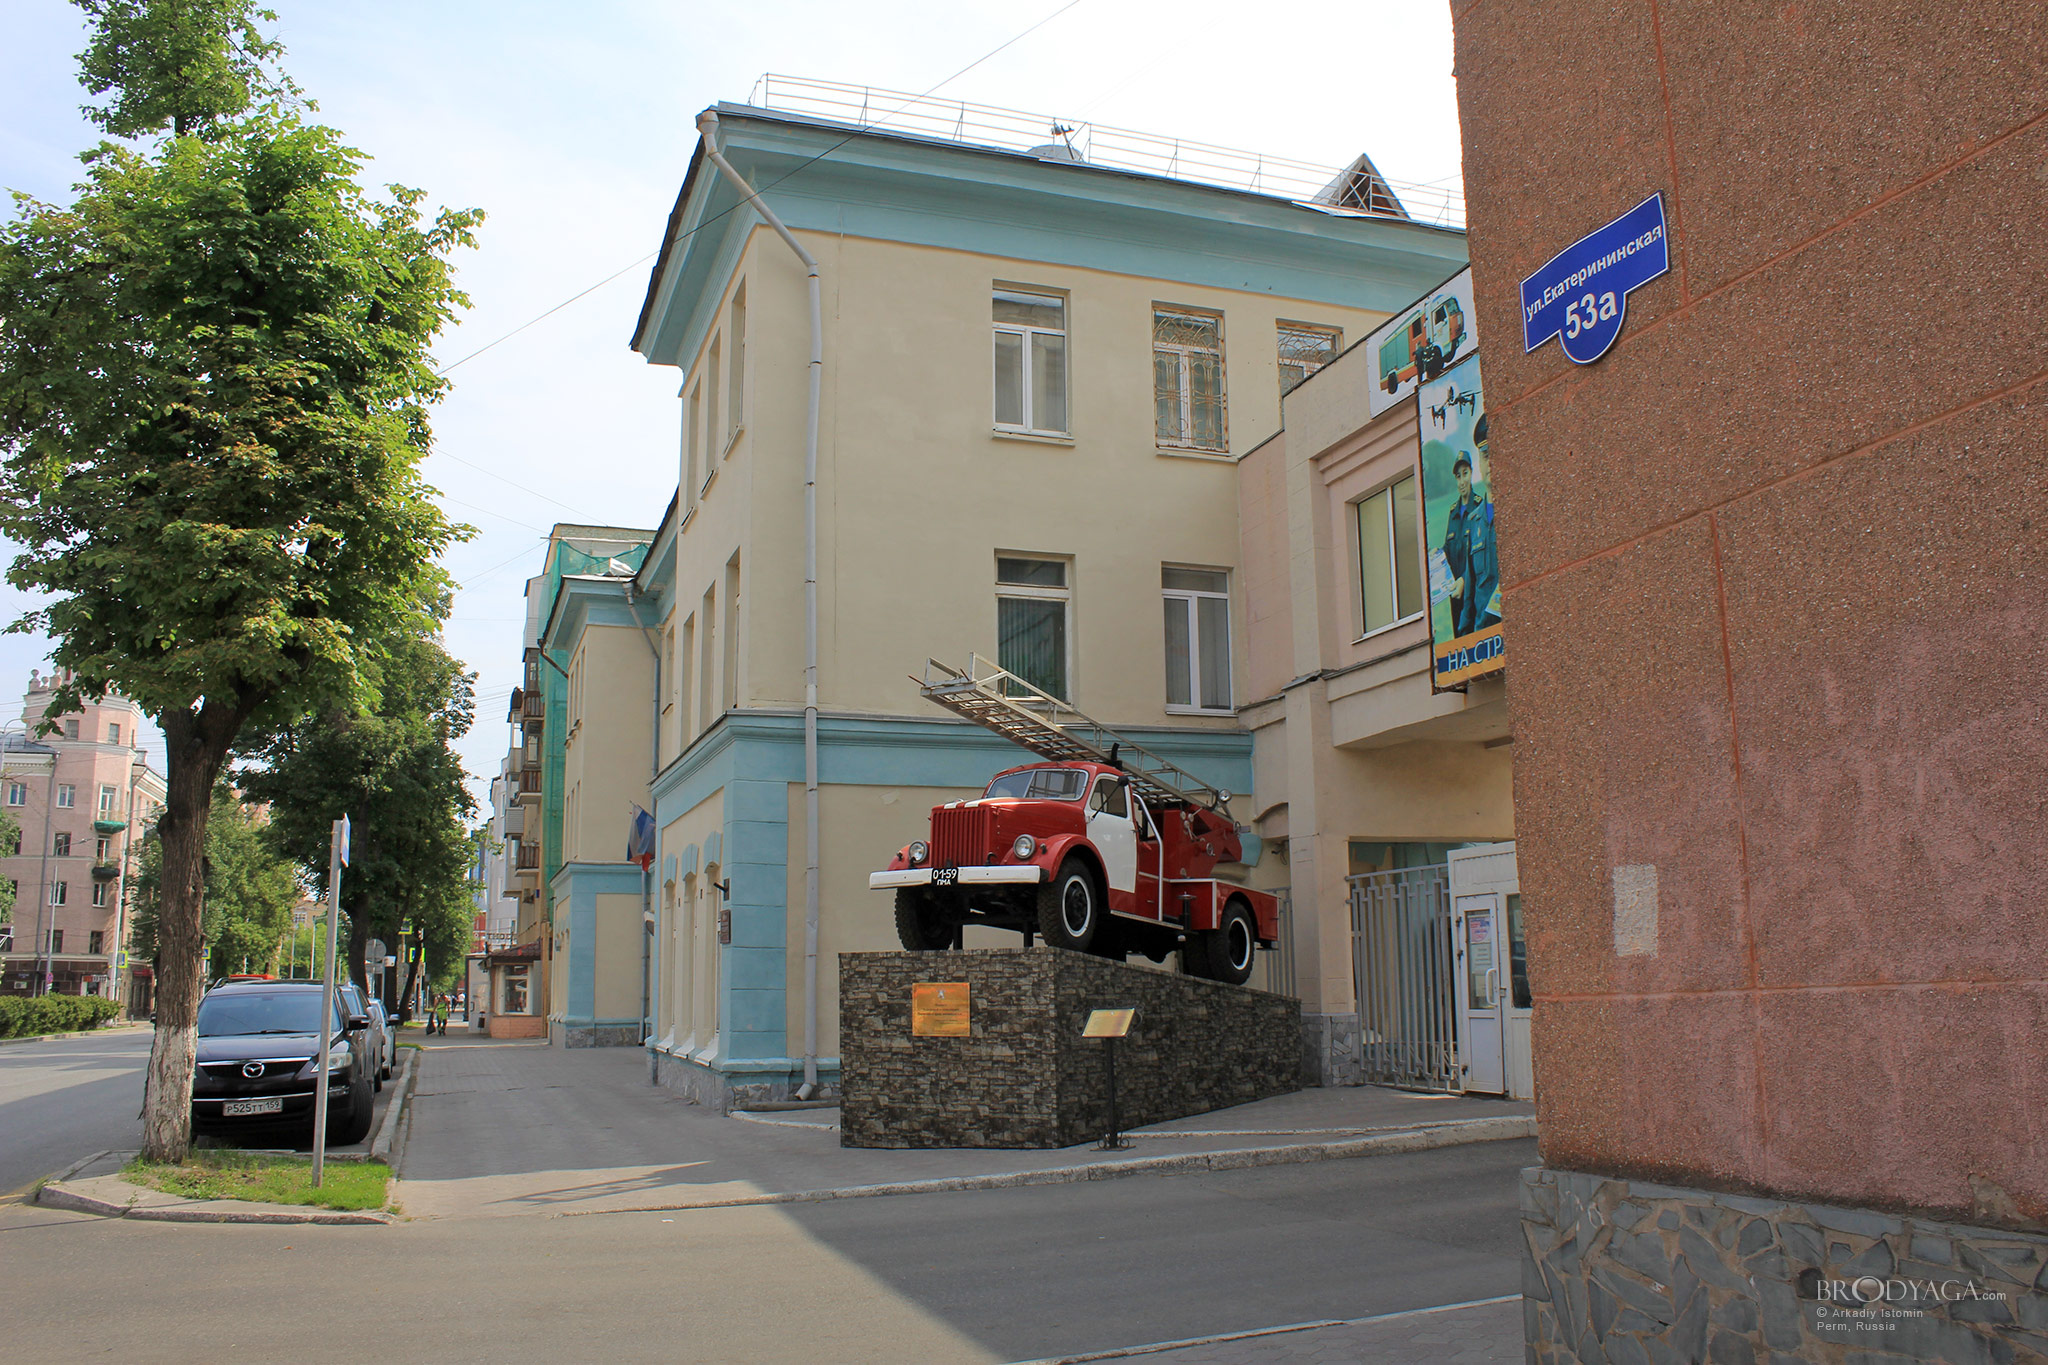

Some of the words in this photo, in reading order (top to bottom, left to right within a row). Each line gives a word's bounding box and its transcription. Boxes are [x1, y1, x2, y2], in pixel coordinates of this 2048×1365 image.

[1526, 225, 1663, 322] ул.Екатерининская
[1565, 291, 1618, 339] 53а
[1447, 647, 1469, 673] НА
[1473, 634, 1504, 663] СТР
[932, 868, 957, 880] 01-59
